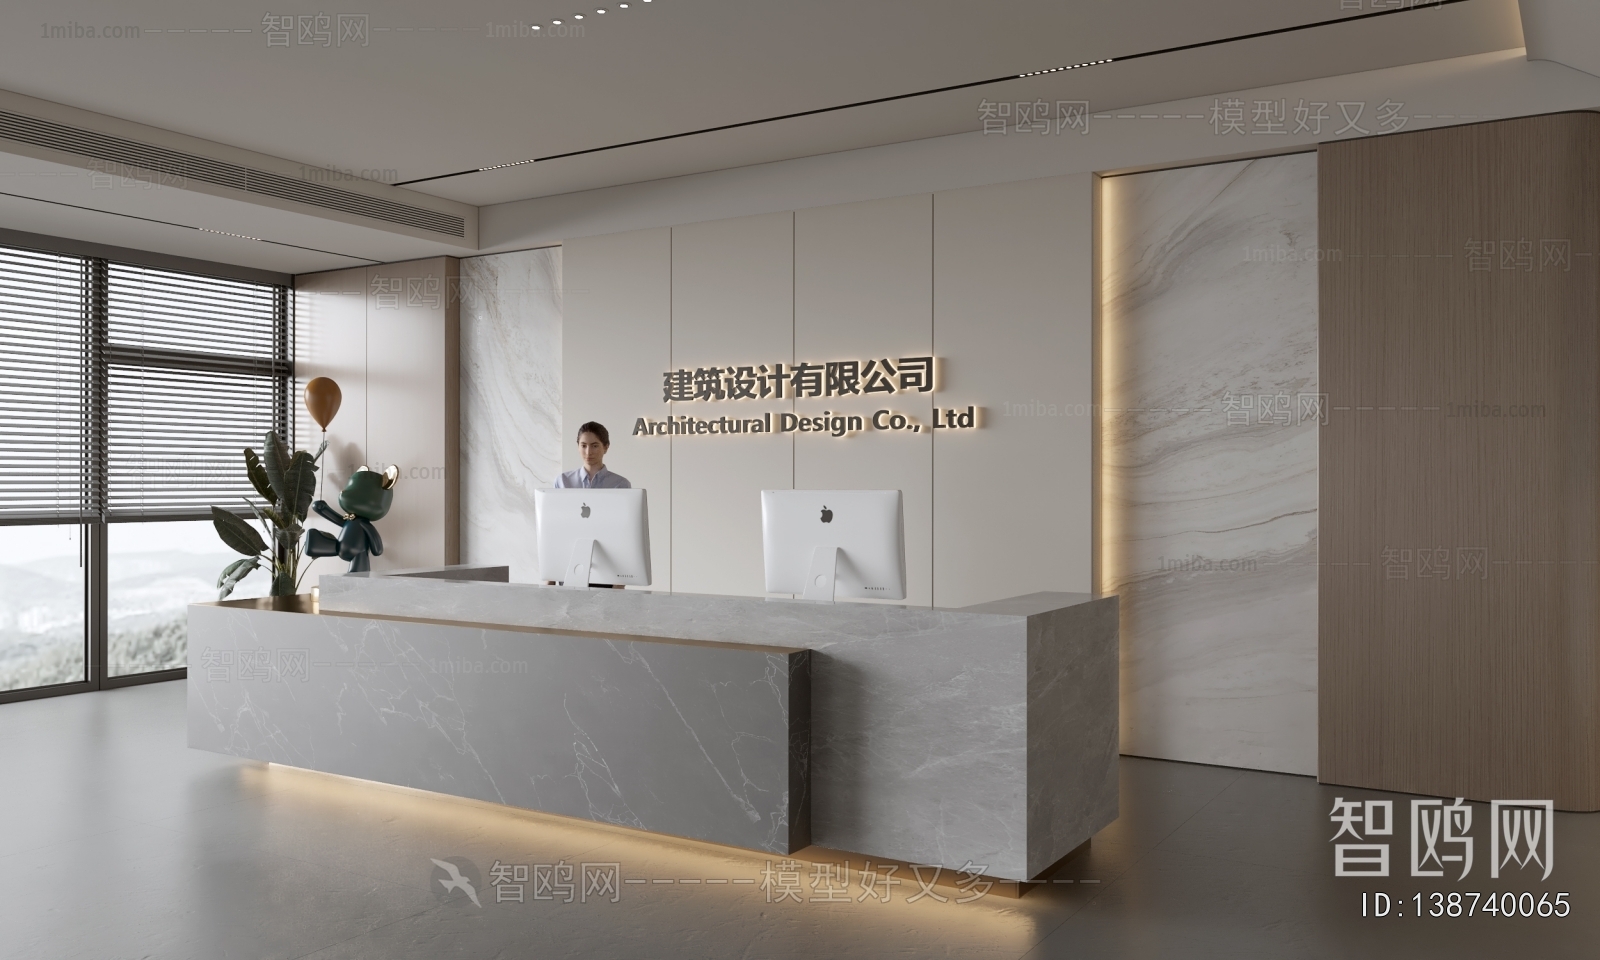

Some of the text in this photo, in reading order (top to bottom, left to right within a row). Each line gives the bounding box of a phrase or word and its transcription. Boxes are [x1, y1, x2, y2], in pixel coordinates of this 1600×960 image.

[662, 356, 935, 403] 建筑设计有限公司
[632, 406, 975, 437] Architectural Design Co., Ltd
